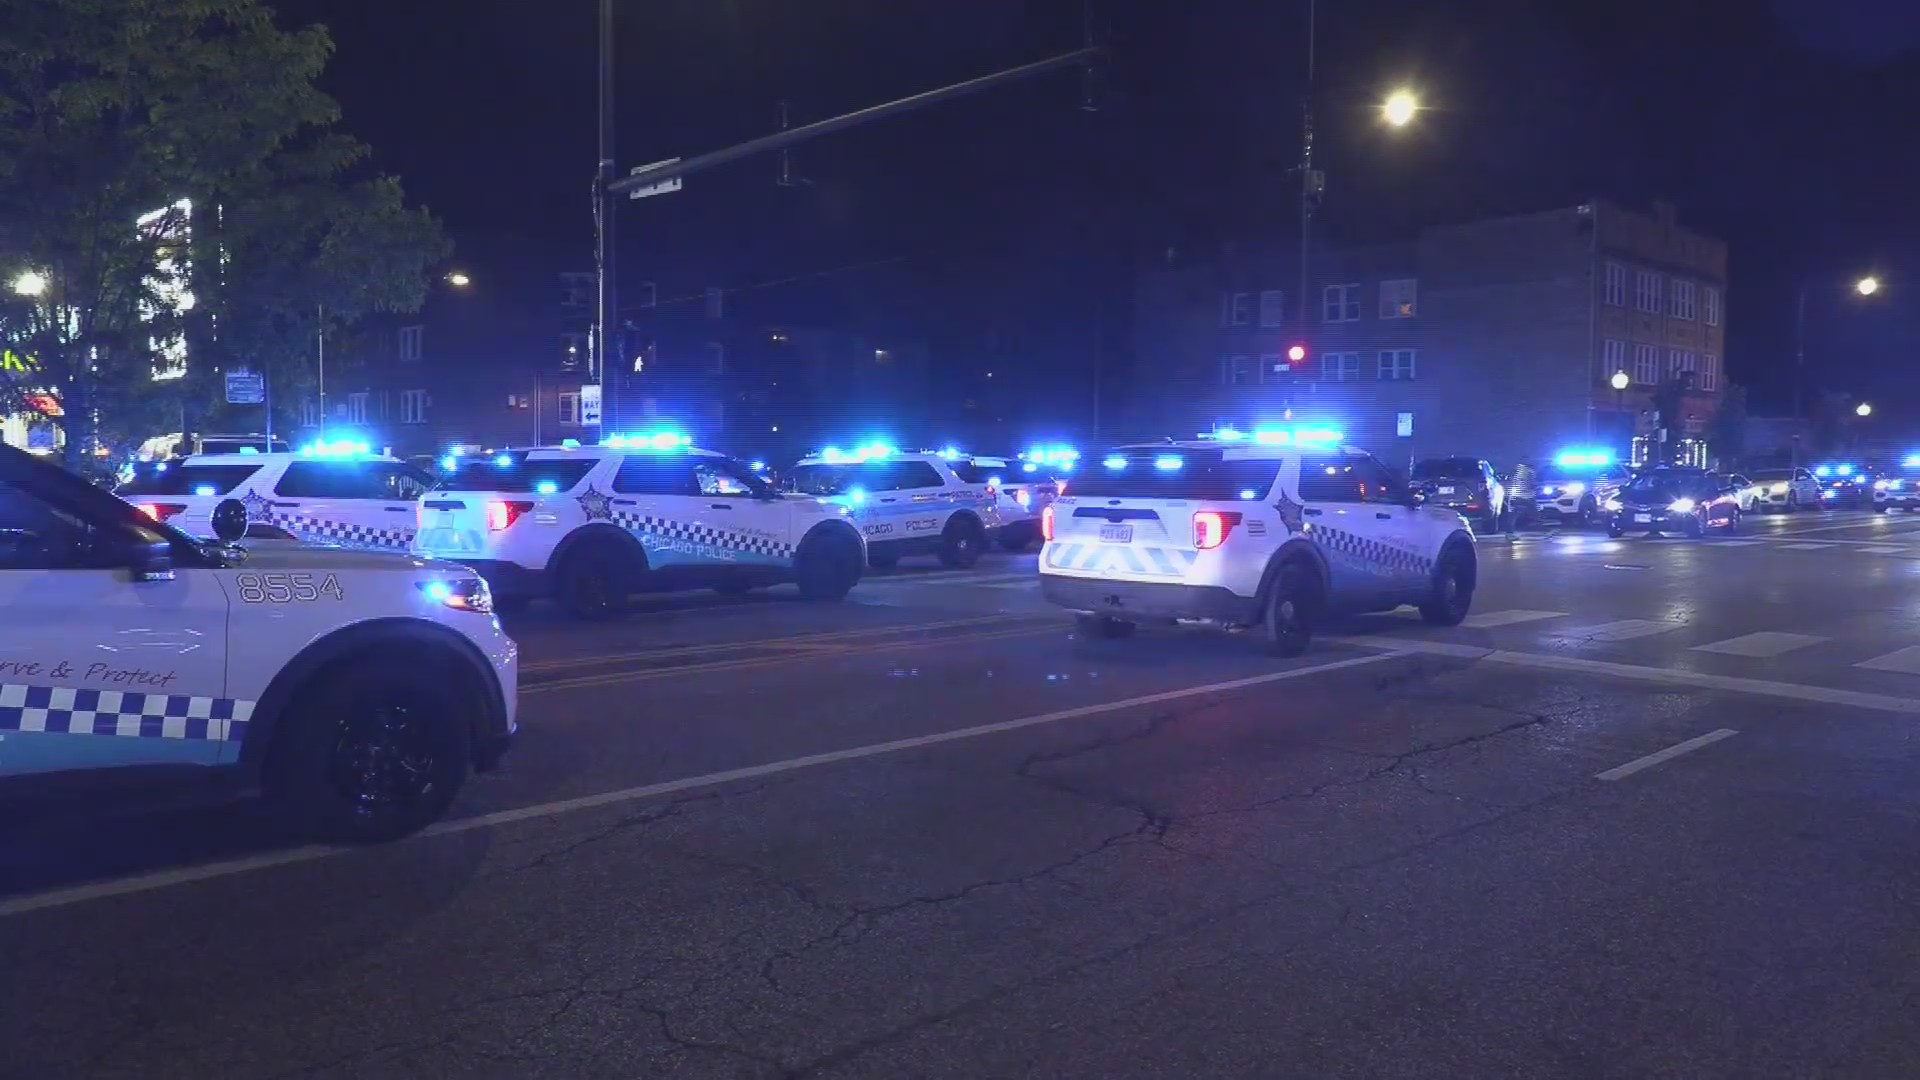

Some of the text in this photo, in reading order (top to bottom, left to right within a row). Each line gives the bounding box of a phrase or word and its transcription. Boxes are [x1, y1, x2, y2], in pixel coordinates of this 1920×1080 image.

[641, 533, 737, 561] CHICAGO POLICE
[236, 573, 343, 603] 8554
[50, 660, 74, 679] &
[84, 662, 177, 688] Protect
